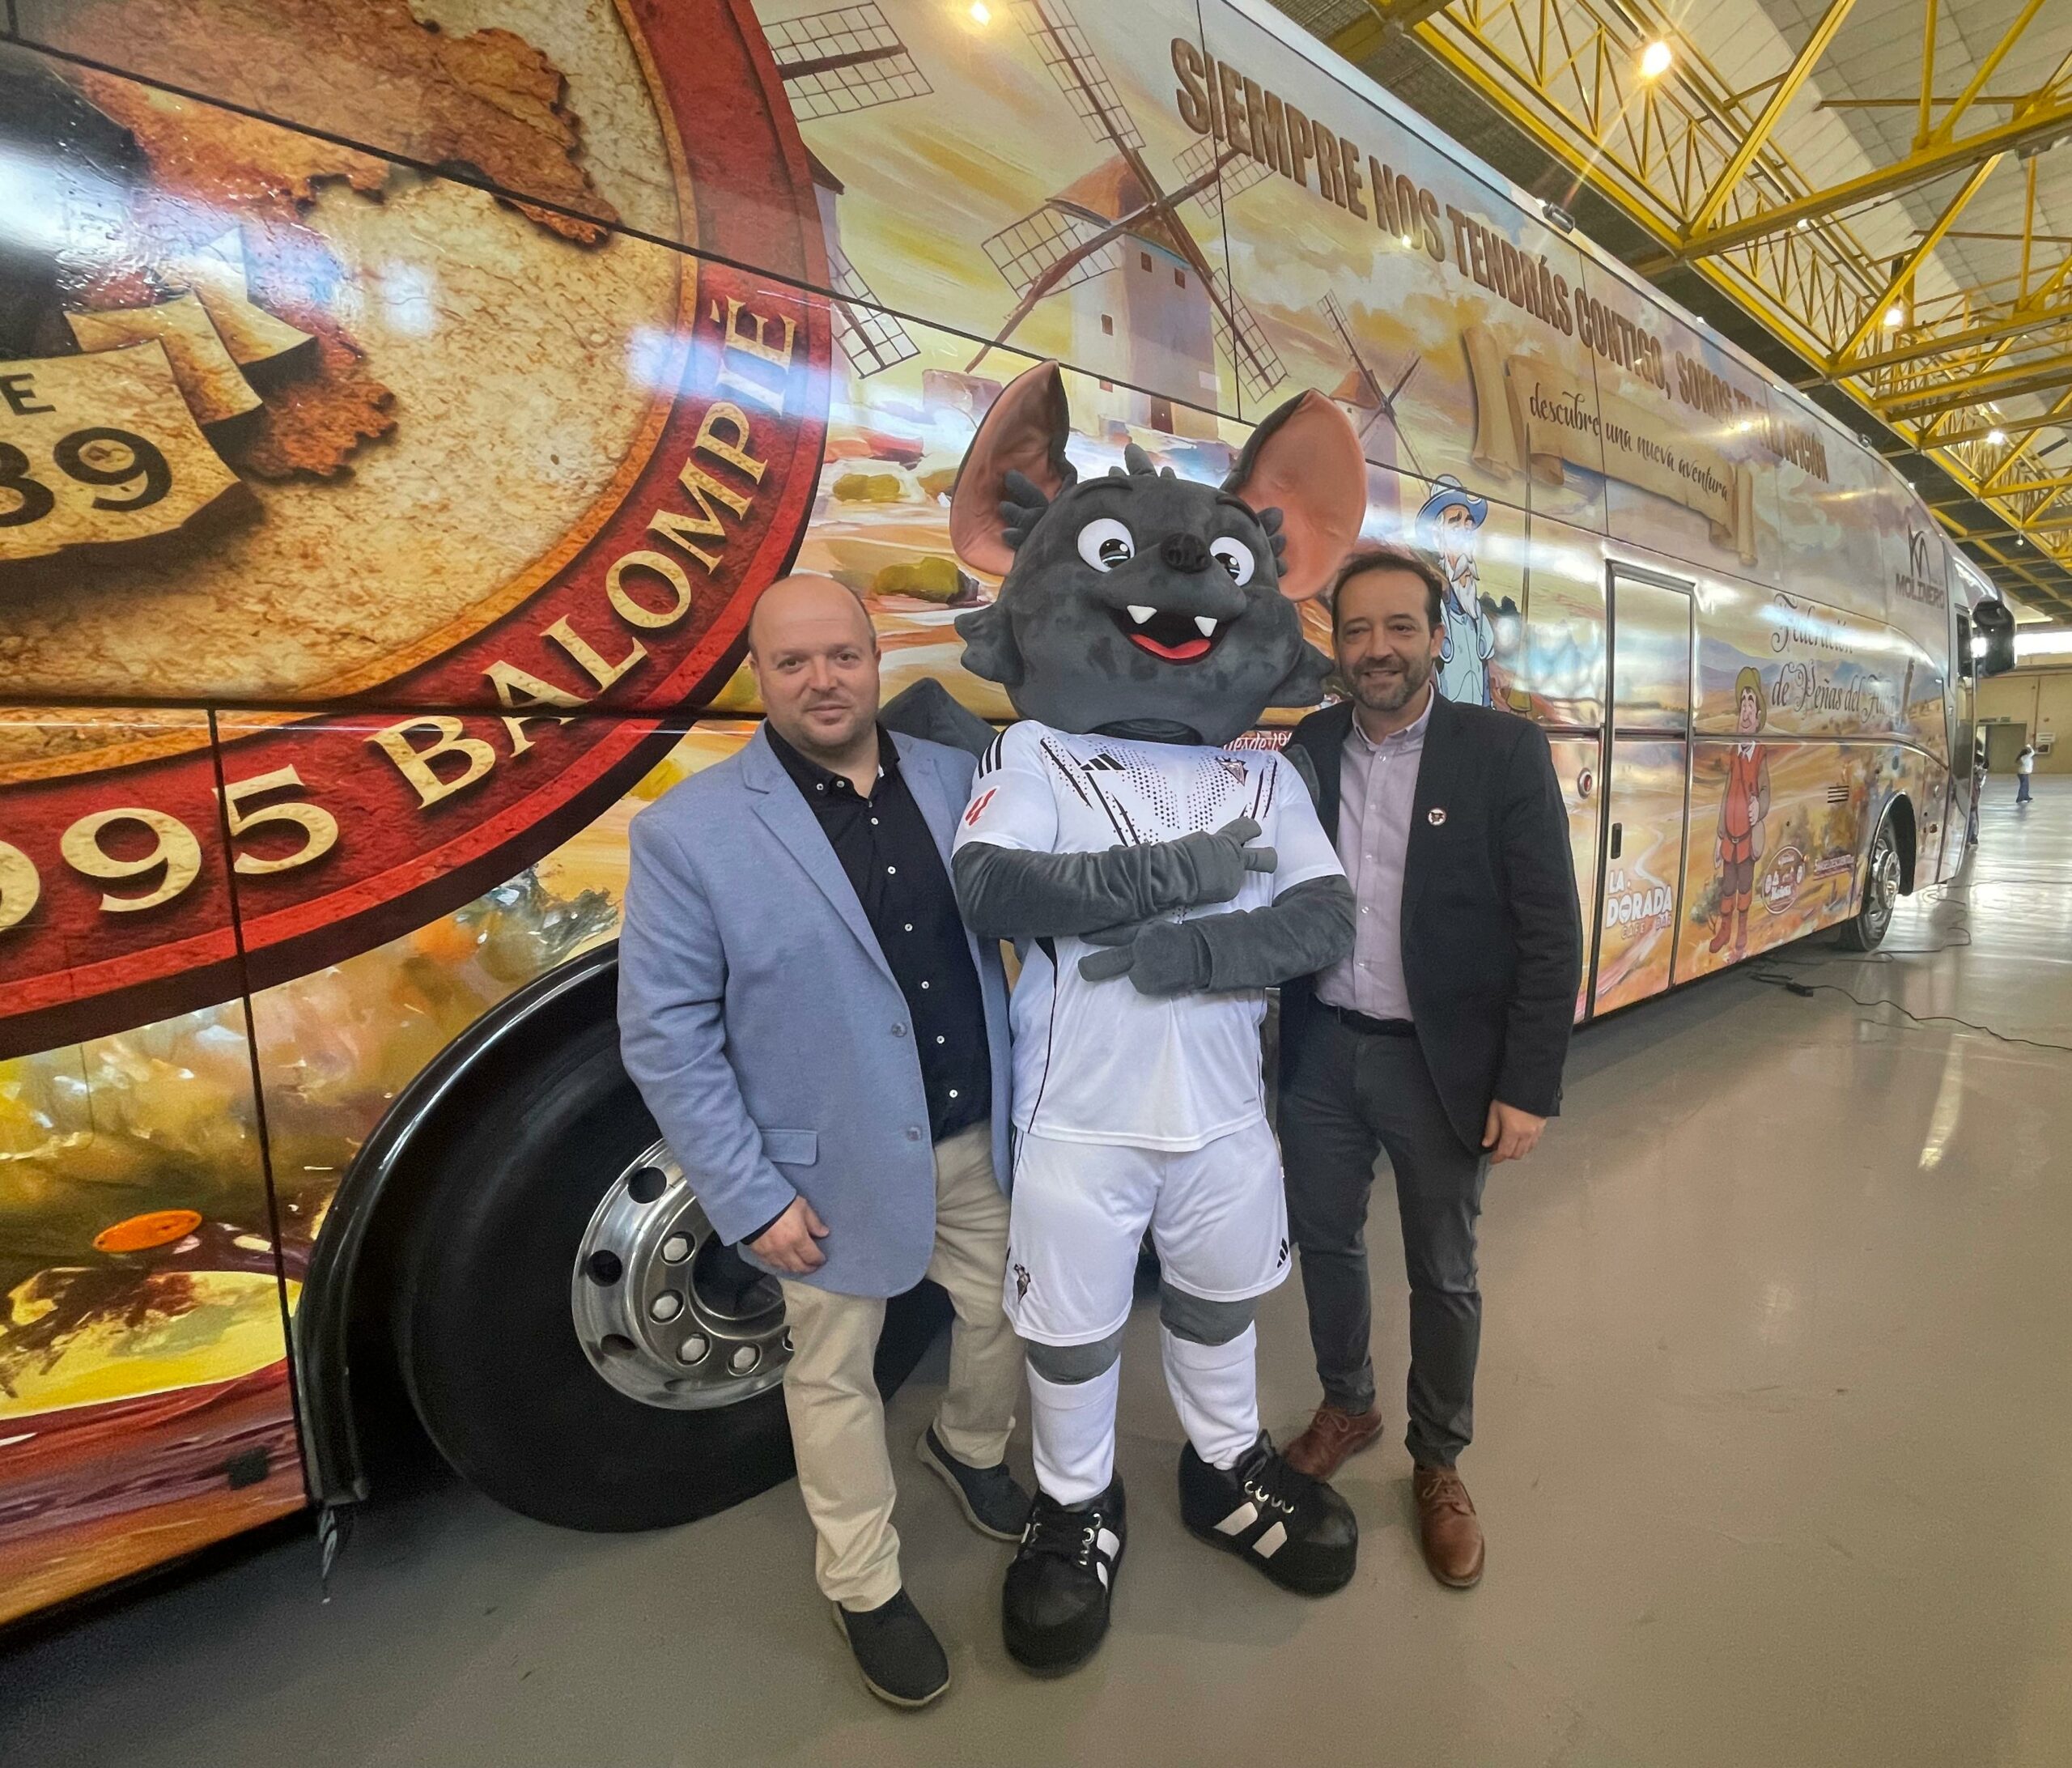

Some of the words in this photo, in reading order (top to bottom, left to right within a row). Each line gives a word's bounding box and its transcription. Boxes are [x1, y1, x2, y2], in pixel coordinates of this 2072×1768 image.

[1170, 37, 1368, 221] SIEMPRE
[1369, 155, 1446, 262] NOS
[1446, 203, 1573, 337] TENDRÁS
[1574, 287, 1671, 400] CONTIGO,
[1675, 350, 1734, 430] SOMOS
[0, 372, 56, 416] E
[1530, 382, 1601, 436] descubre
[1605, 422, 1633, 453] una
[1637, 436, 1675, 471] nueva
[1678, 459, 1728, 502] aventura
[364, 295, 796, 810] BALOMPIÉ
[1772, 661, 1794, 706] de
[1789, 659, 1841, 712] Peñas
[1844, 675, 1866, 712] del
[0, 763, 339, 933] 95
[1609, 869, 1625, 895] LA
[1606, 885, 1673, 929] DORADA
